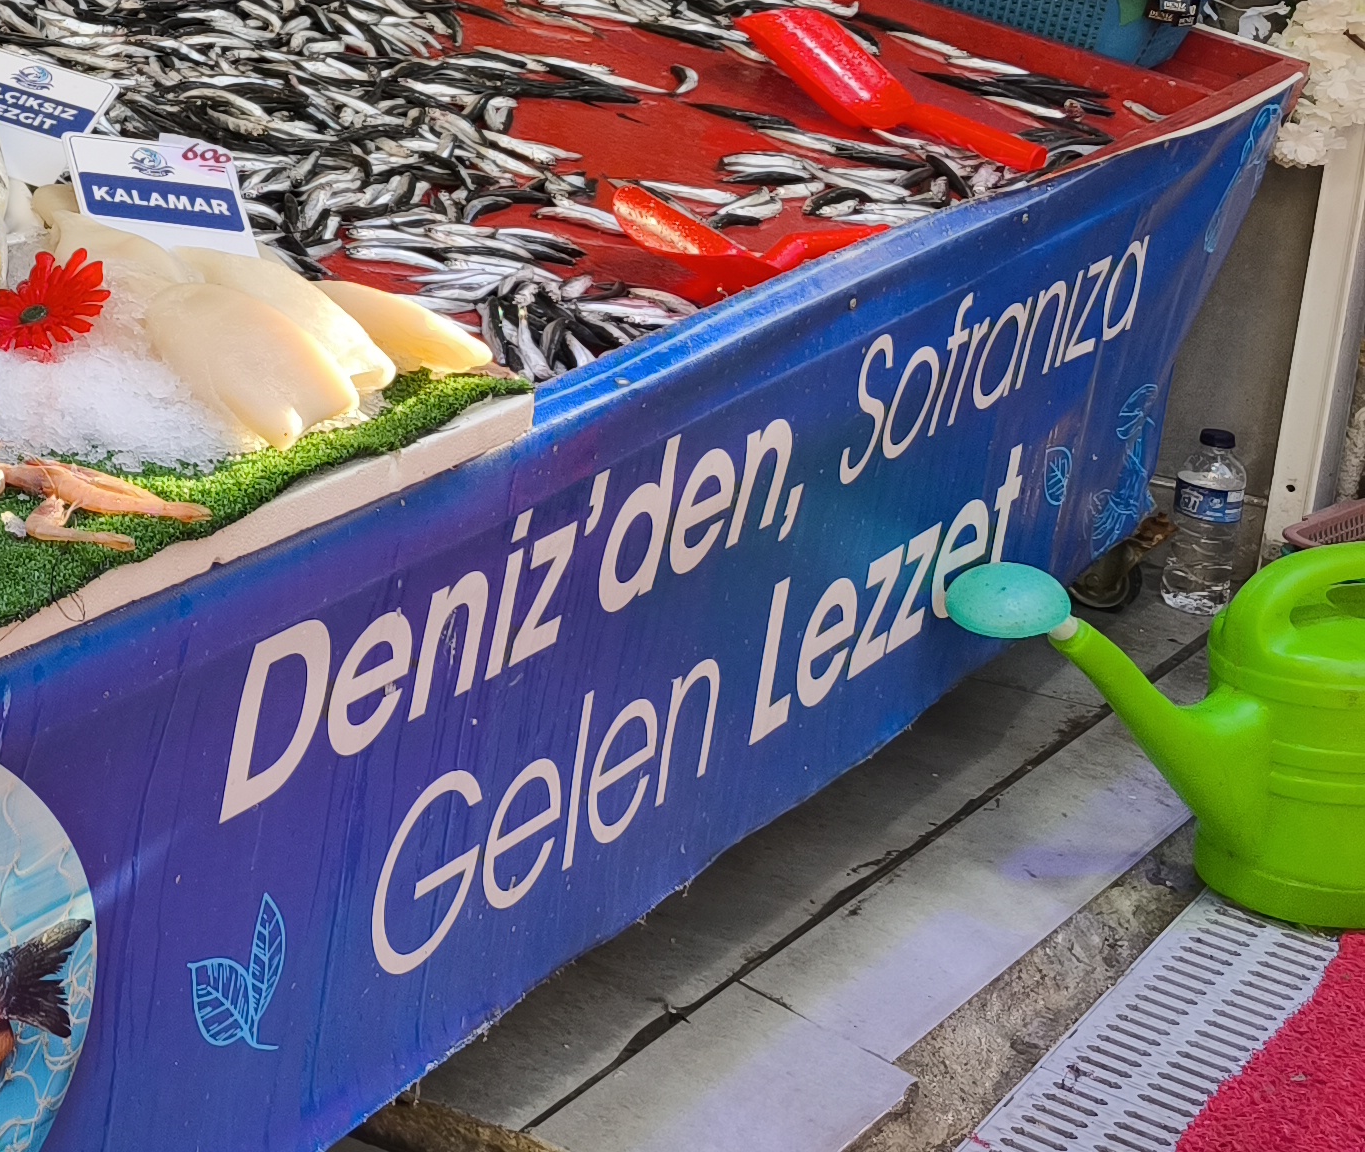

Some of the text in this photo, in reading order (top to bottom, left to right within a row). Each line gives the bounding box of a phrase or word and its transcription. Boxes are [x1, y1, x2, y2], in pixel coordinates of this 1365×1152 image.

[91, 185, 232, 216] KALAMAR
[181, 142, 232, 164] 600
[218, 235, 1150, 825] Deniz'den, Sofranıza
[370, 443, 1023, 975] Gelen Lezzet
